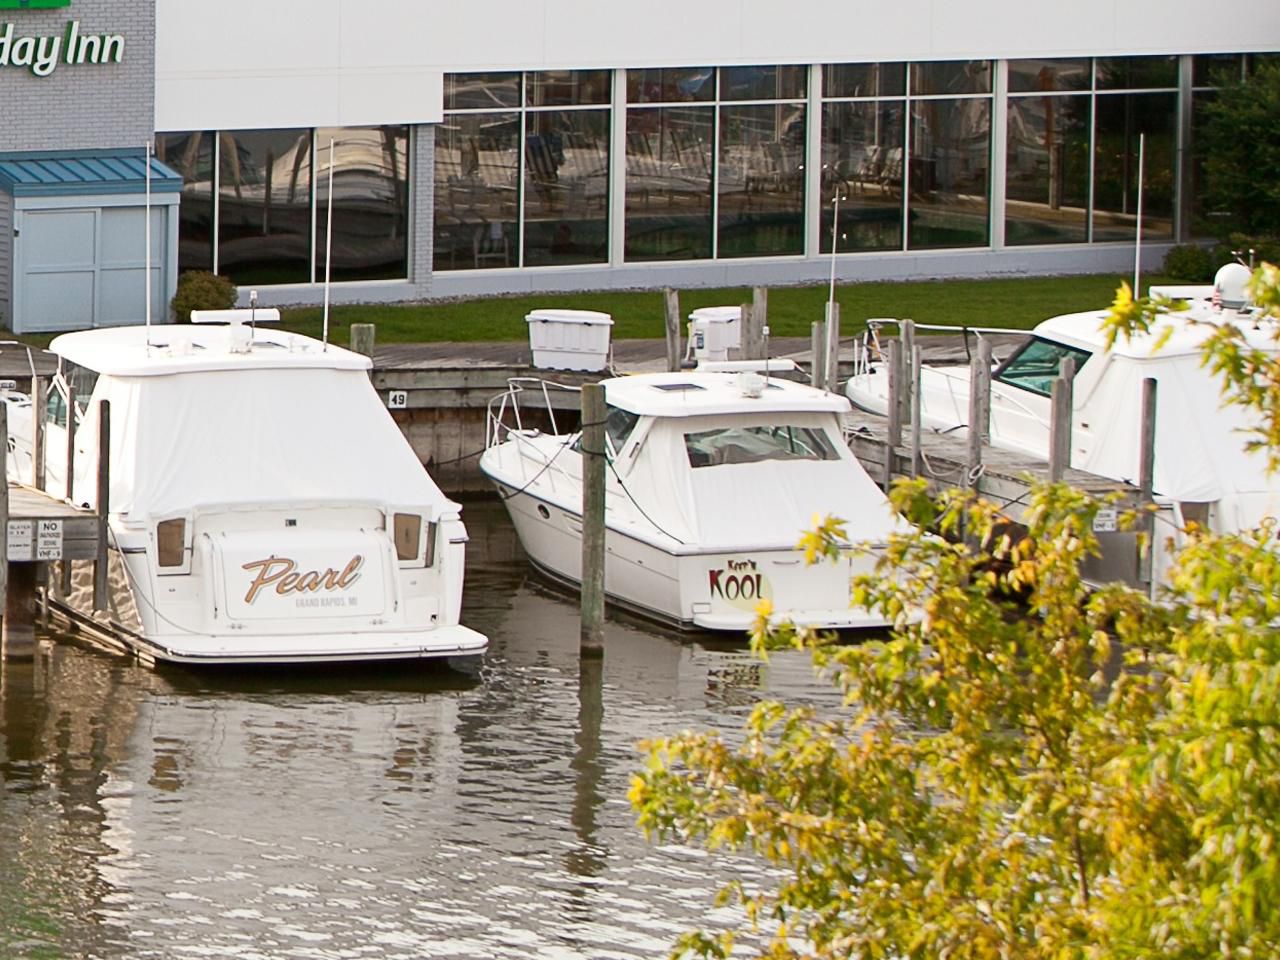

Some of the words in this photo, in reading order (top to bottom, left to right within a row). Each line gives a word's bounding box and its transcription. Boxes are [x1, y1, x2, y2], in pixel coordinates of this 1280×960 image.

[66, 20, 125, 64] Inn
[391, 394, 405, 405] 49
[43, 522, 57, 530] NO
[241, 554, 364, 604] Pearl
